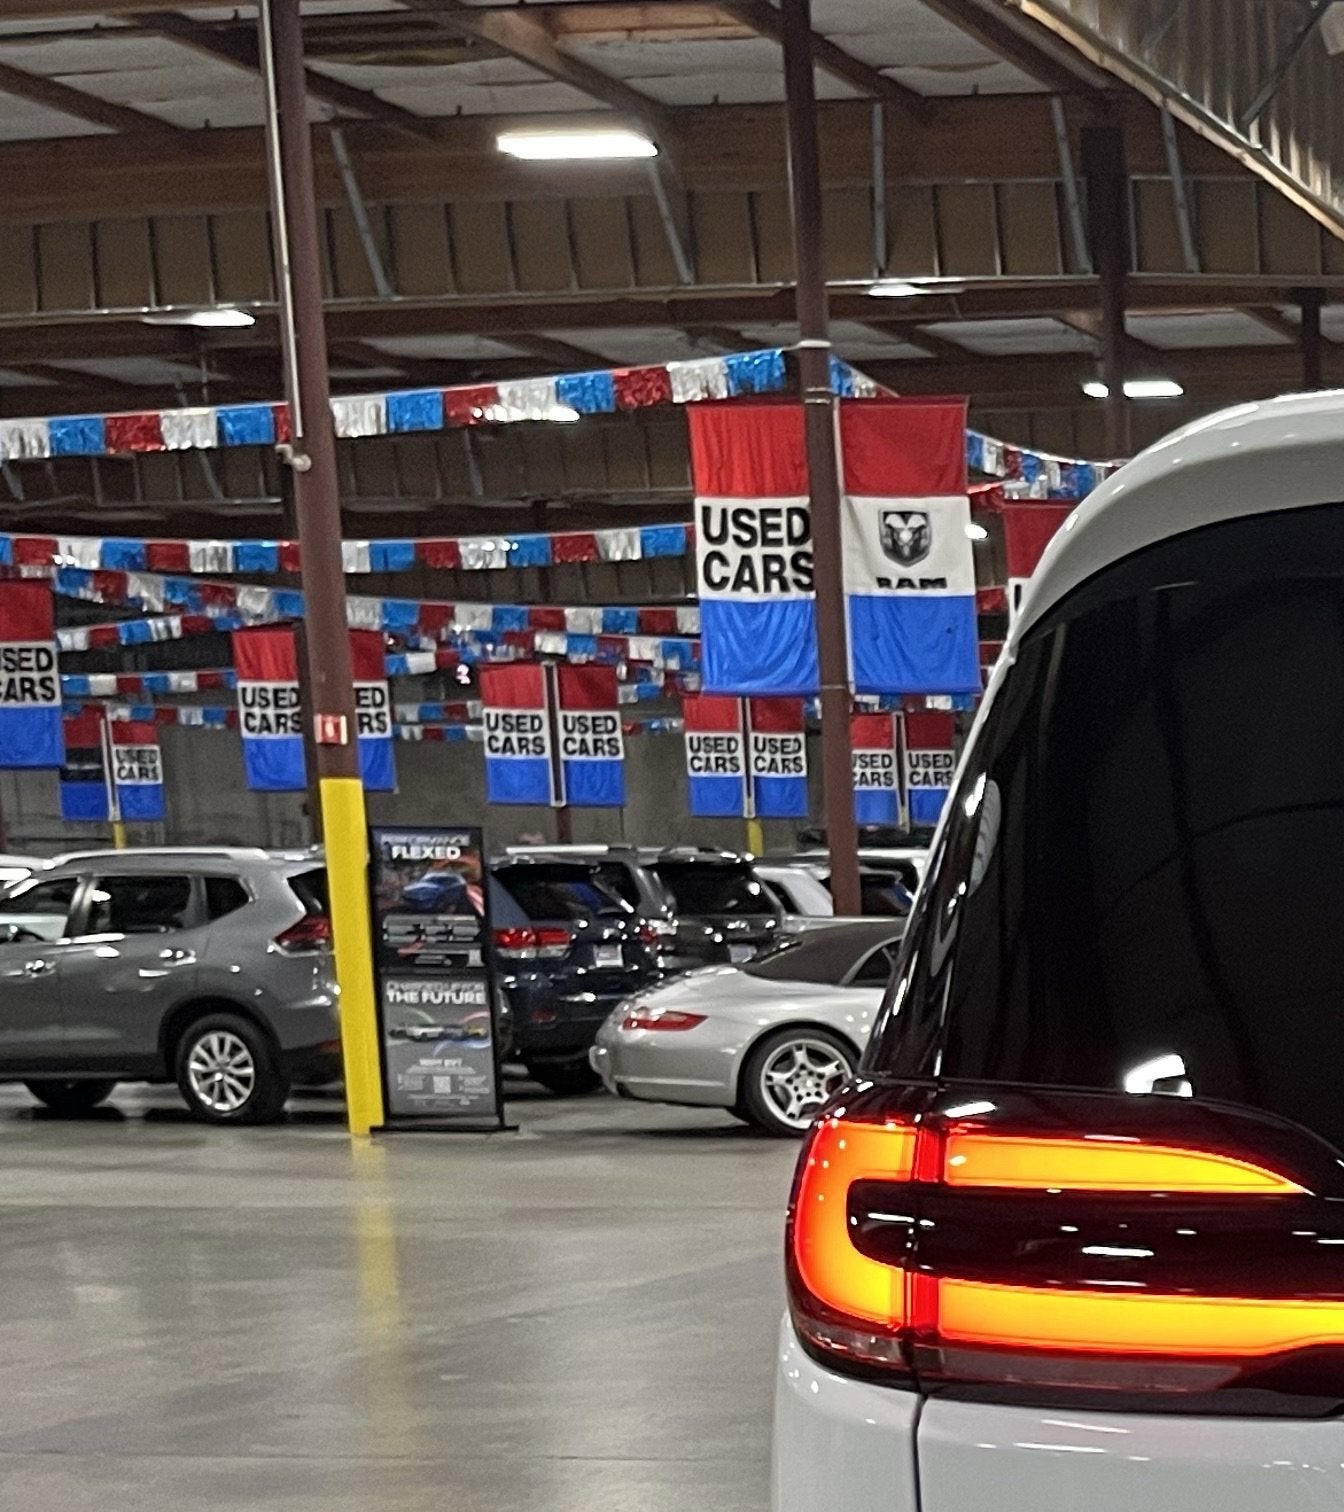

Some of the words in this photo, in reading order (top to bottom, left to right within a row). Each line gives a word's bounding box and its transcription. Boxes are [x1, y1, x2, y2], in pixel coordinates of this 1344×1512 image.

[701, 505, 812, 549] USED
[702, 550, 814, 594] CARS
[876, 576, 948, 590] RAM
[0, 647, 54, 672] SED
[0, 676, 56, 702] ARS
[241, 686, 301, 709] USED
[354, 686, 386, 709] ED
[244, 711, 304, 734] CARS
[357, 711, 389, 734] RS
[486, 712, 544, 734] USED
[562, 714, 618, 735] USED
[487, 735, 546, 756] CARS
[562, 737, 621, 757] CARS
[688, 735, 740, 755] USED
[754, 736, 801, 755] USED
[116, 748, 158, 764] USED
[689, 755, 741, 774] CARS
[754, 755, 804, 774] CARS
[908, 752, 953, 769] USED
[117, 765, 159, 781] CARS
[387, 989, 419, 1003] THE
[421, 990, 486, 1004] FUTURE
